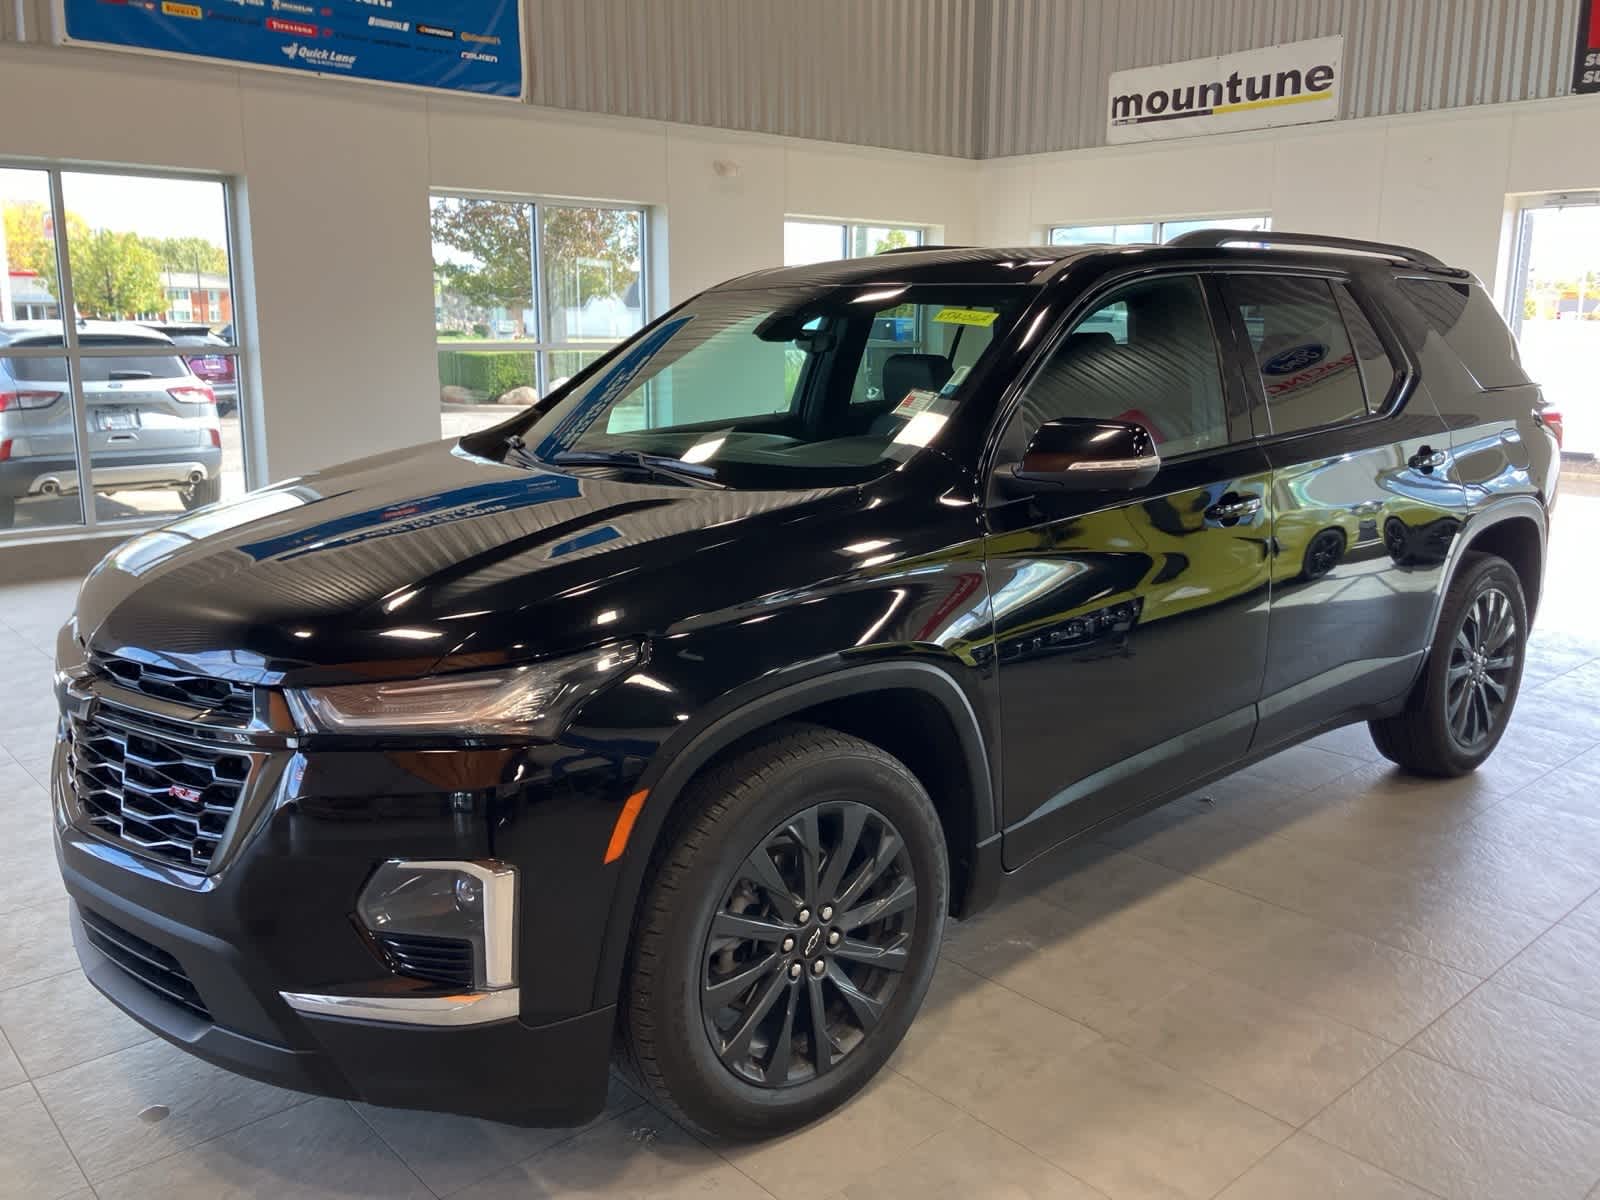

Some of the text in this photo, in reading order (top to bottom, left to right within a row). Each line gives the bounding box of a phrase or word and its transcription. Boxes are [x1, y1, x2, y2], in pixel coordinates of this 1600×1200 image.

[298, 45, 329, 59] Quick
[330, 51, 357, 64] Lane
[1112, 65, 1334, 119] mountune
